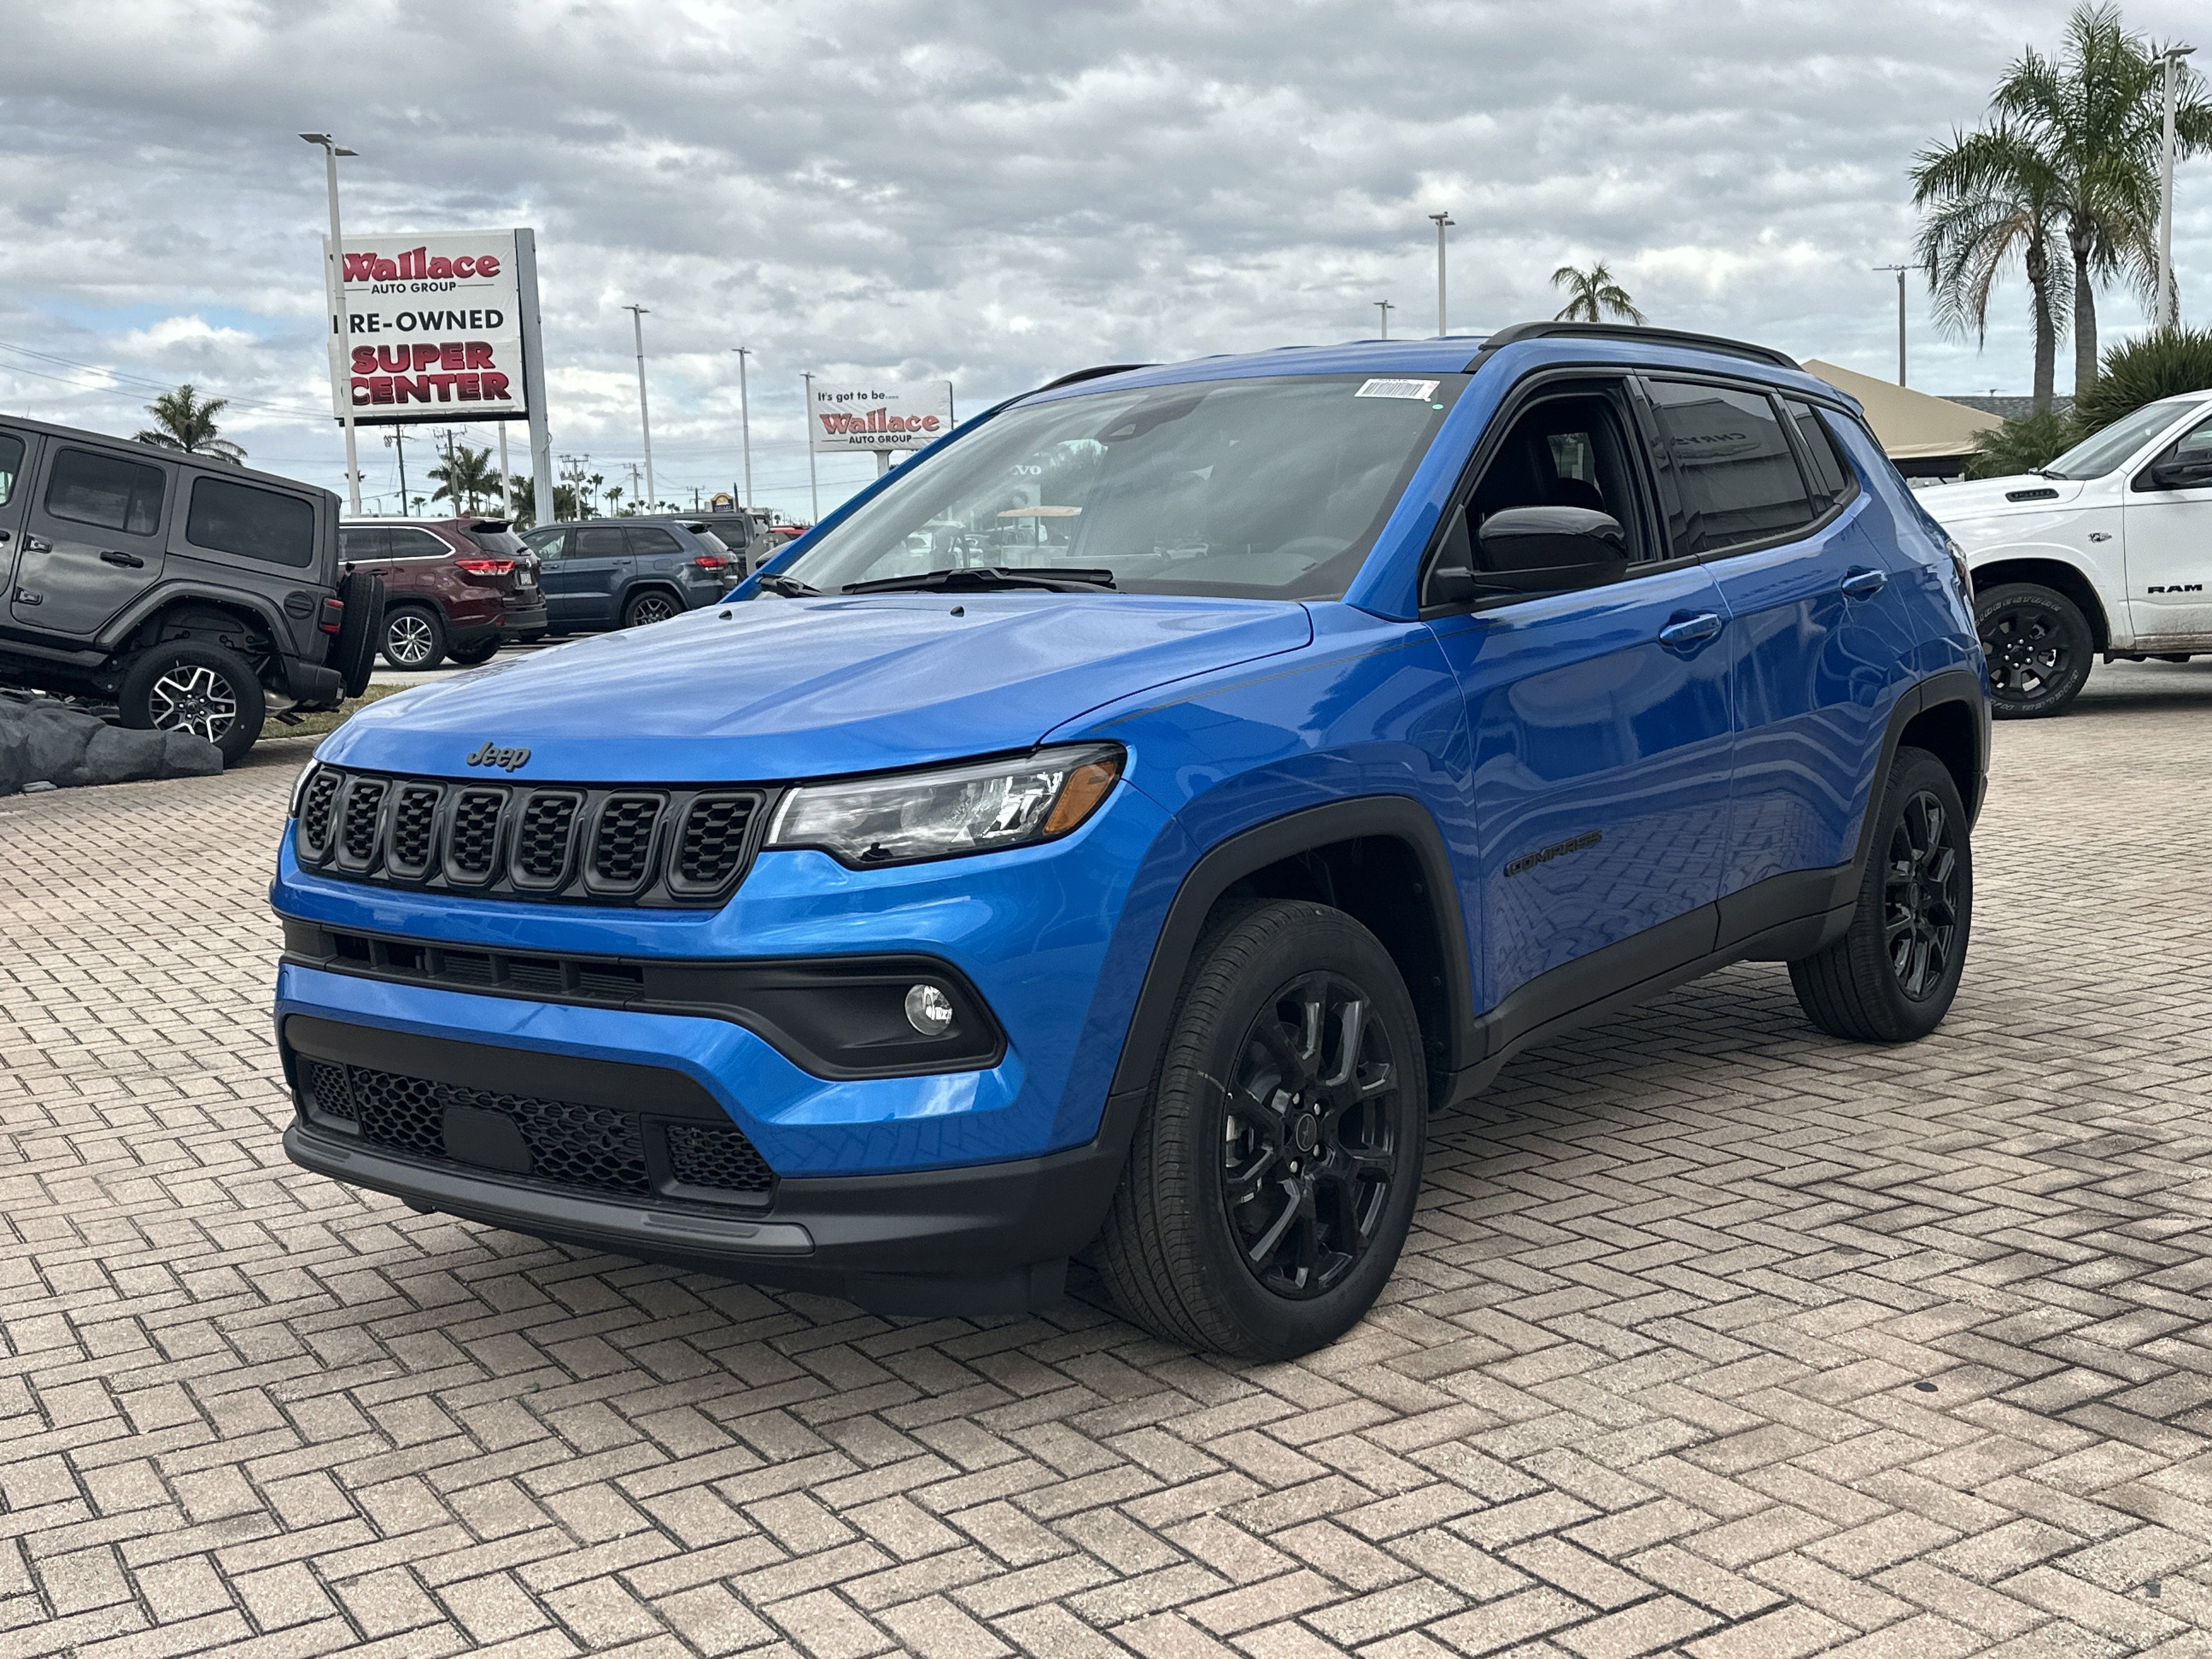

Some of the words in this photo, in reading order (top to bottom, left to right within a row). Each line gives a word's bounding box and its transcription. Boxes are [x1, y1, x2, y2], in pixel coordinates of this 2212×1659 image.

[330, 246, 501, 282] Wallace
[371, 283, 406, 295] AUTO
[411, 281, 456, 294] GROUP
[351, 341, 496, 374] SUPER
[341, 372, 512, 405] CENTER
[818, 392, 832, 401] It's
[836, 392, 853, 403] got
[857, 392, 867, 400] to
[820, 408, 940, 435] Wallace
[849, 436, 874, 444] AUTO
[878, 435, 912, 443] GROUP
[2148, 584, 2202, 594] RAM
[466, 741, 531, 772] Jeep
[1504, 829, 1602, 877] COMPASS
